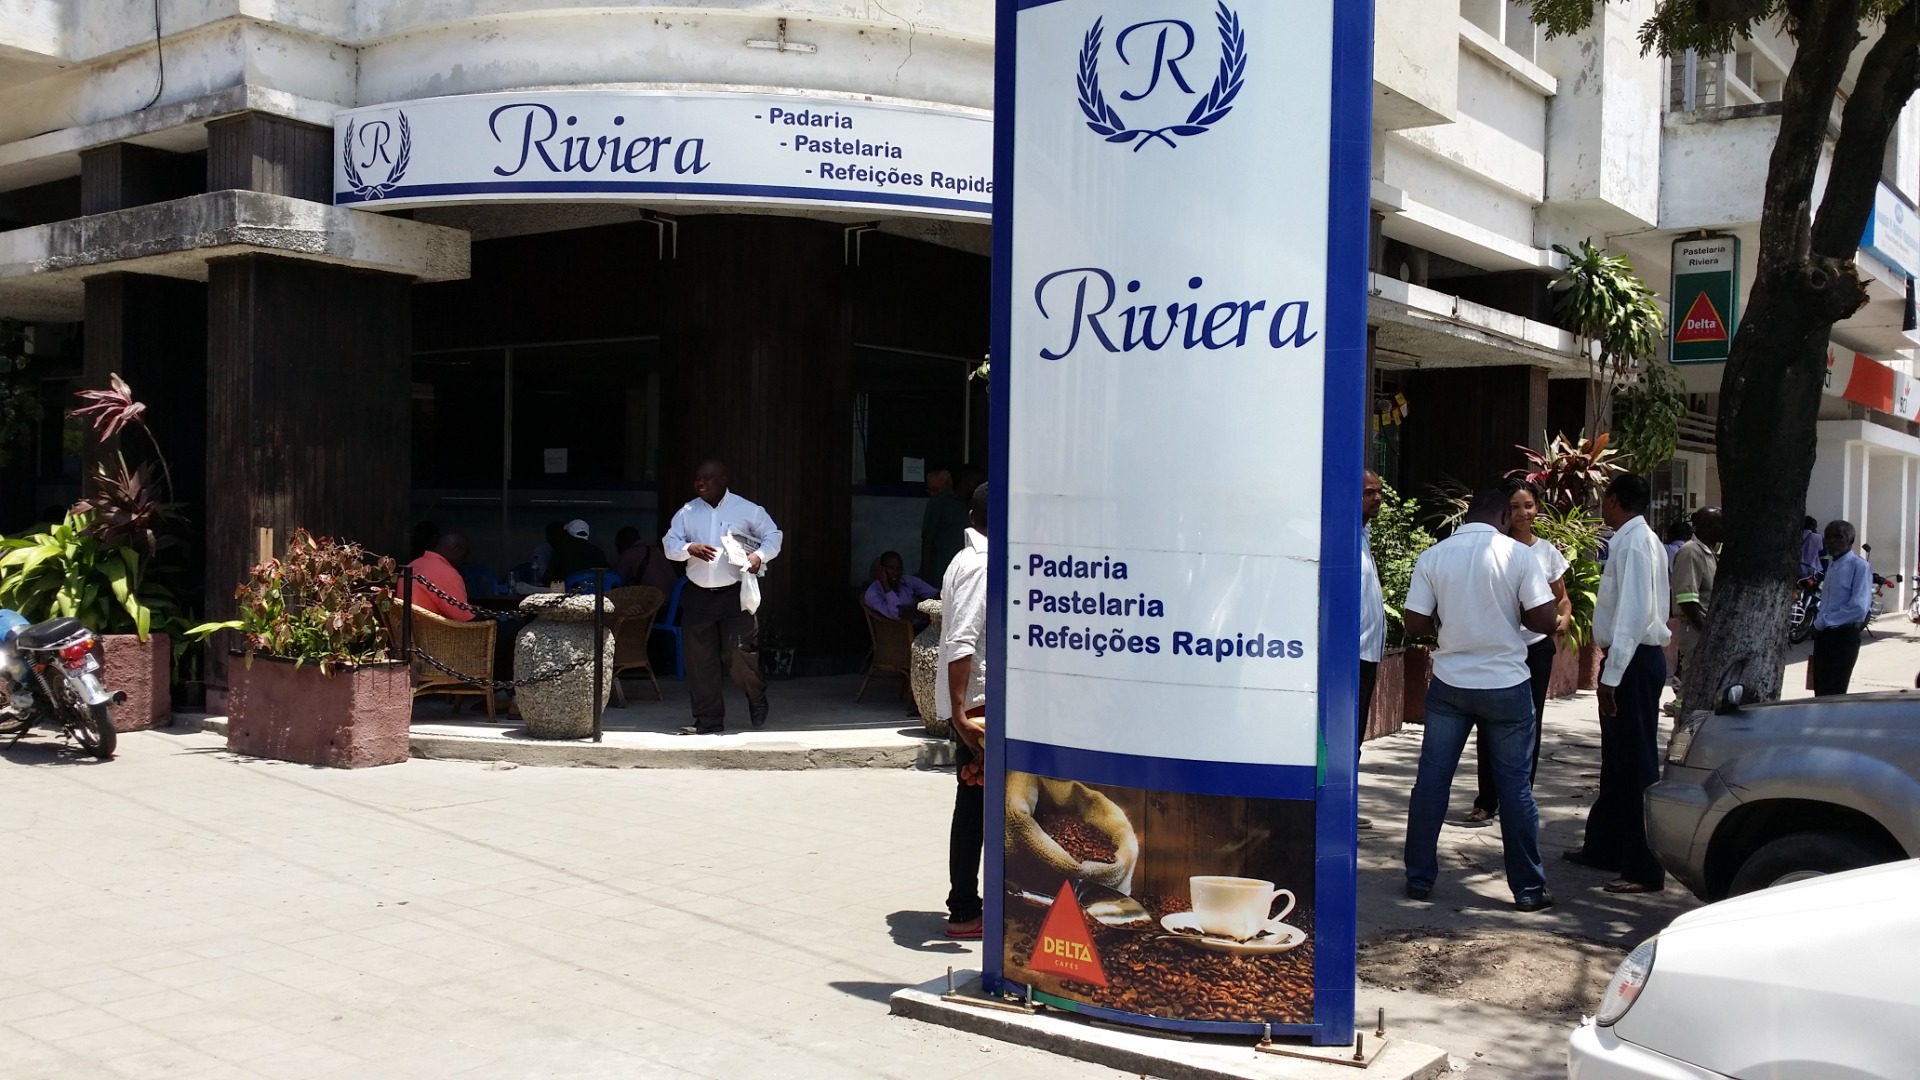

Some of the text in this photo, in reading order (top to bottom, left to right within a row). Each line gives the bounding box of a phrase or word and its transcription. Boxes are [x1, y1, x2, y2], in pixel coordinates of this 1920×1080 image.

[1116, 19, 1196, 101] R
[770, 107, 852, 129] Padaria
[359, 120, 391, 168] R
[489, 103, 711, 176] Riviera
[795, 135, 902, 159] Pastelaria
[820, 162, 923, 187] Refeições
[930, 171, 993, 194] Rapida
[1683, 246, 1725, 256] Pastelaria
[1689, 257, 1719, 267] Riviera
[1034, 267, 1318, 361] Riviera
[1687, 319, 1716, 330] Delta
[1029, 554, 1128, 580] Padaria
[1028, 590, 1164, 618] Pastelaria
[1028, 624, 1161, 657] Refeições
[1173, 631, 1304, 662] Rapidas
[1044, 936, 1092, 963] DELTA
